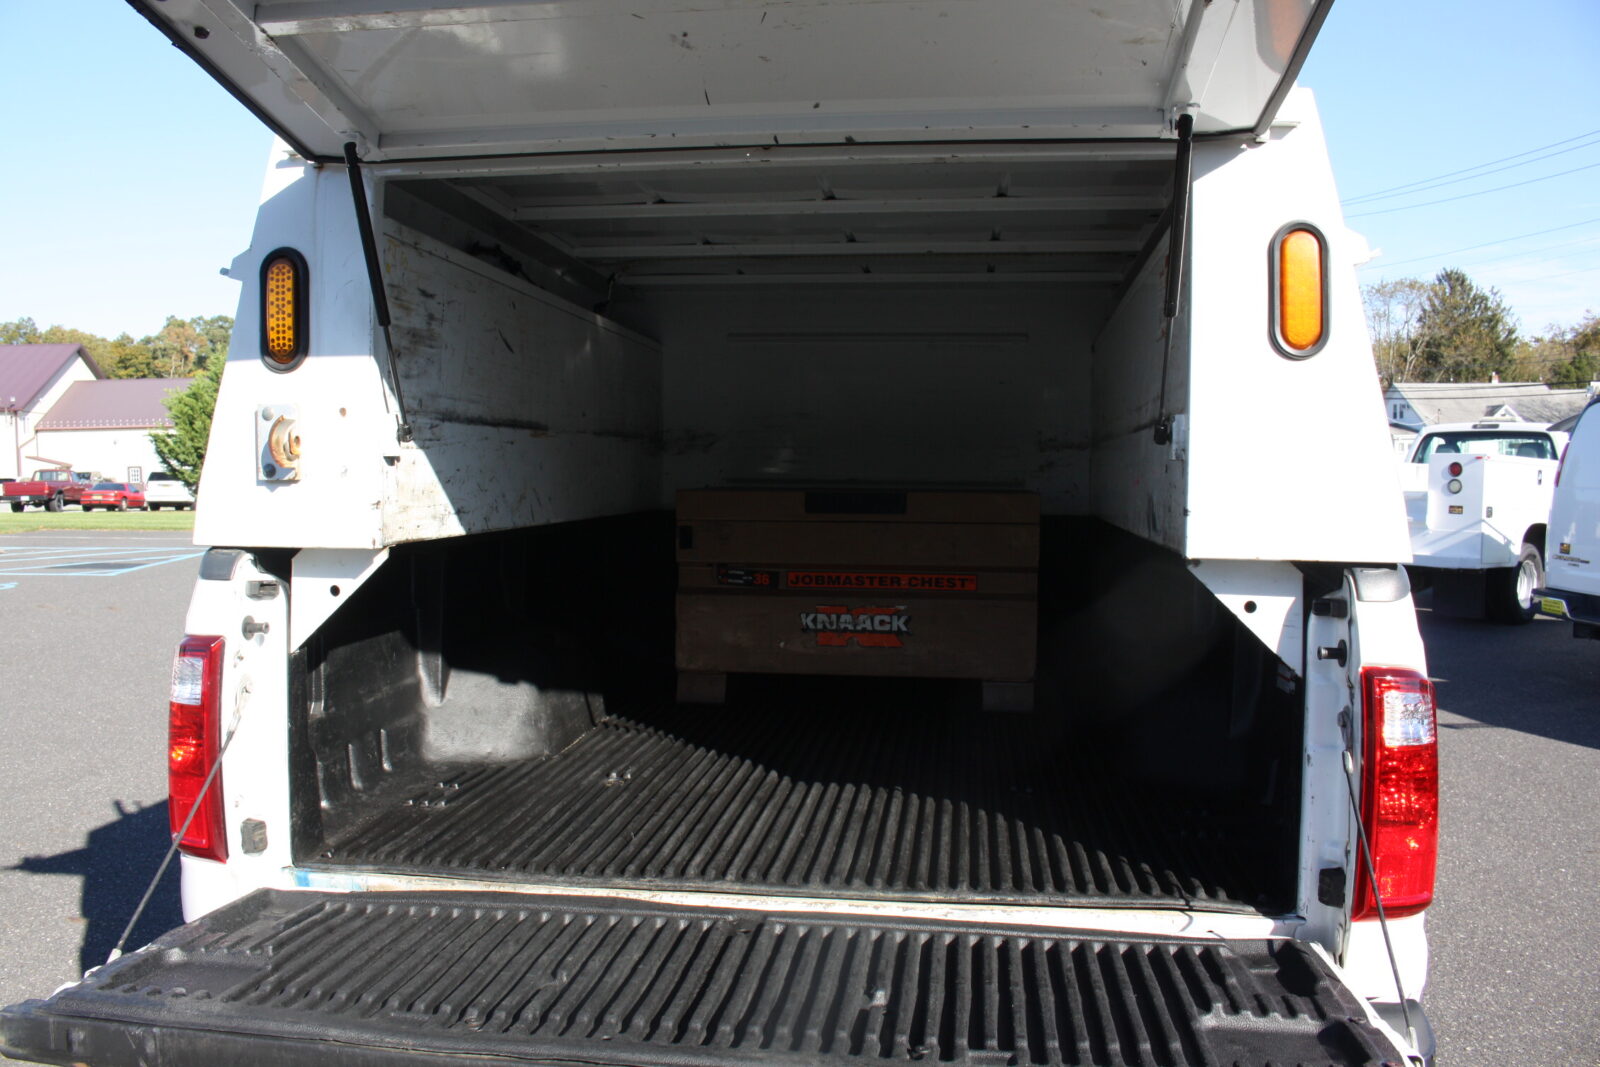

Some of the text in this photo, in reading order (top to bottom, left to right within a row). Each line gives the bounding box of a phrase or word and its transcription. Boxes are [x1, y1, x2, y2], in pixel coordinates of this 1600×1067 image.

[753, 574, 770, 585] 36
[790, 574, 969, 589] JOBMASTER CHEST
[800, 612, 910, 632] KNAACK
